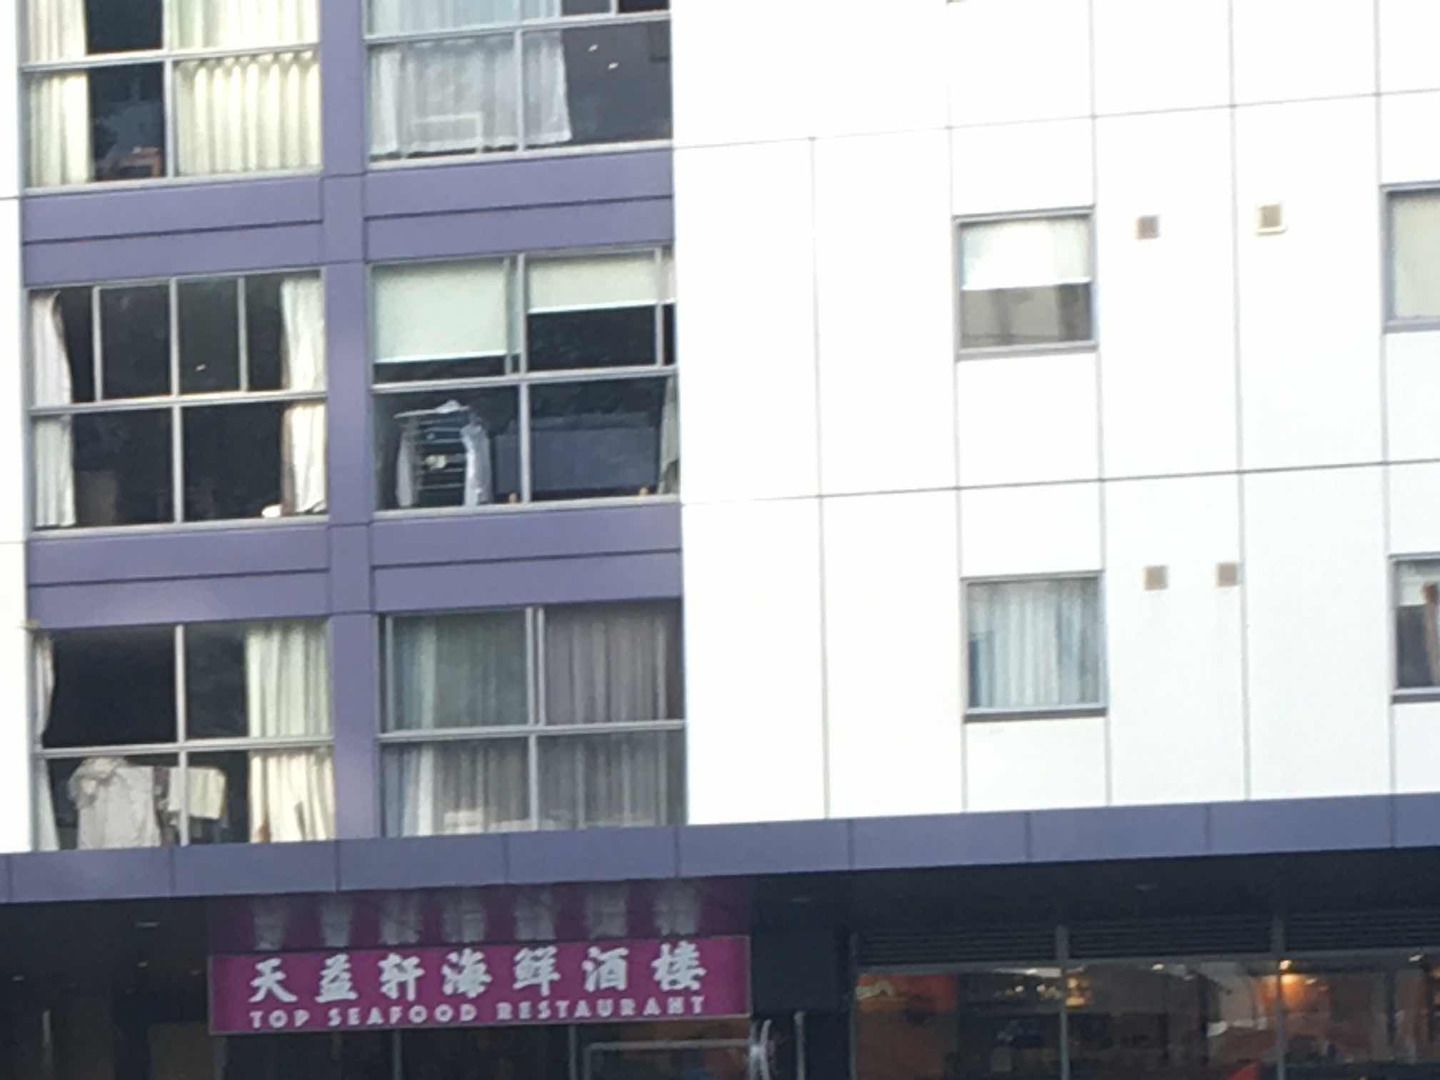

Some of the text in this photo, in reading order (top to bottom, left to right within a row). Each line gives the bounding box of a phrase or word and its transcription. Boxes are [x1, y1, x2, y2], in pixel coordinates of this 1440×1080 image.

[249, 996, 705, 1028] TOP SEAFOOD RESTAURANT
